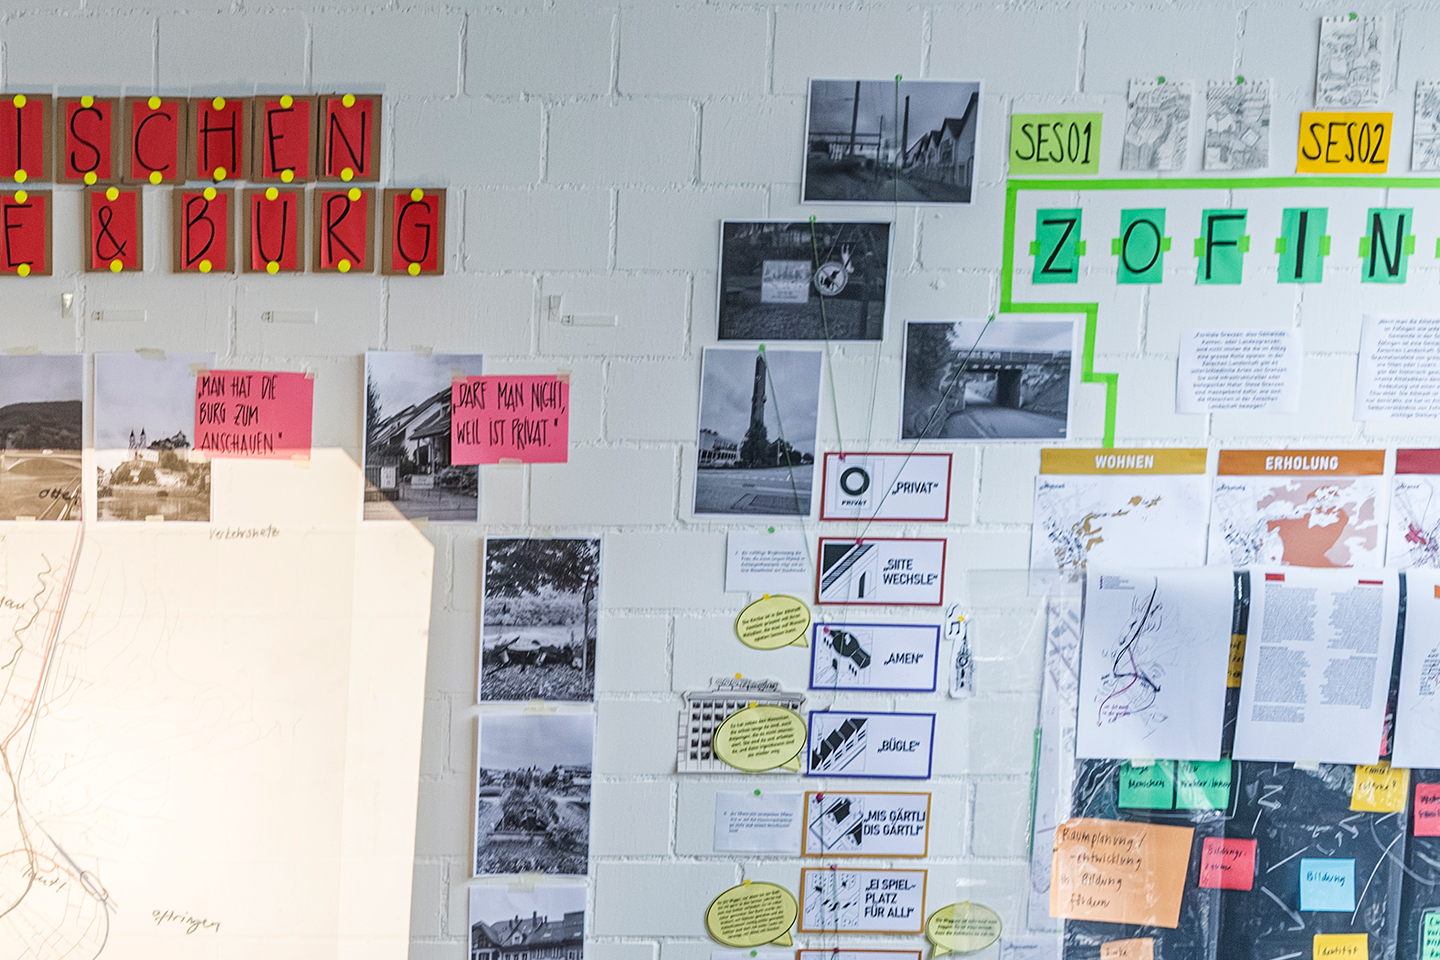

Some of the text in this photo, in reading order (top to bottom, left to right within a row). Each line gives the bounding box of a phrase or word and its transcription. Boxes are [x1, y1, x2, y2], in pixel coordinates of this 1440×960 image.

[1015, 122, 1092, 164] SES01
[1302, 122, 1385, 164] SES02
[96, 205, 128, 262] &
[230, 375, 253, 398] HAT
[261, 374, 278, 400] DIE
[498, 380, 524, 410] MAN
[199, 402, 259, 426] BURG ZUM
[457, 418, 481, 446] WEIL
[1094, 454, 1155, 470] WOHNEN
[1264, 455, 1340, 471] ERHOLUNG
[1306, 870, 1347, 887] Bildung
[864, 903, 885, 918] FÜR
[865, 892, 898, 905] PLATZ
